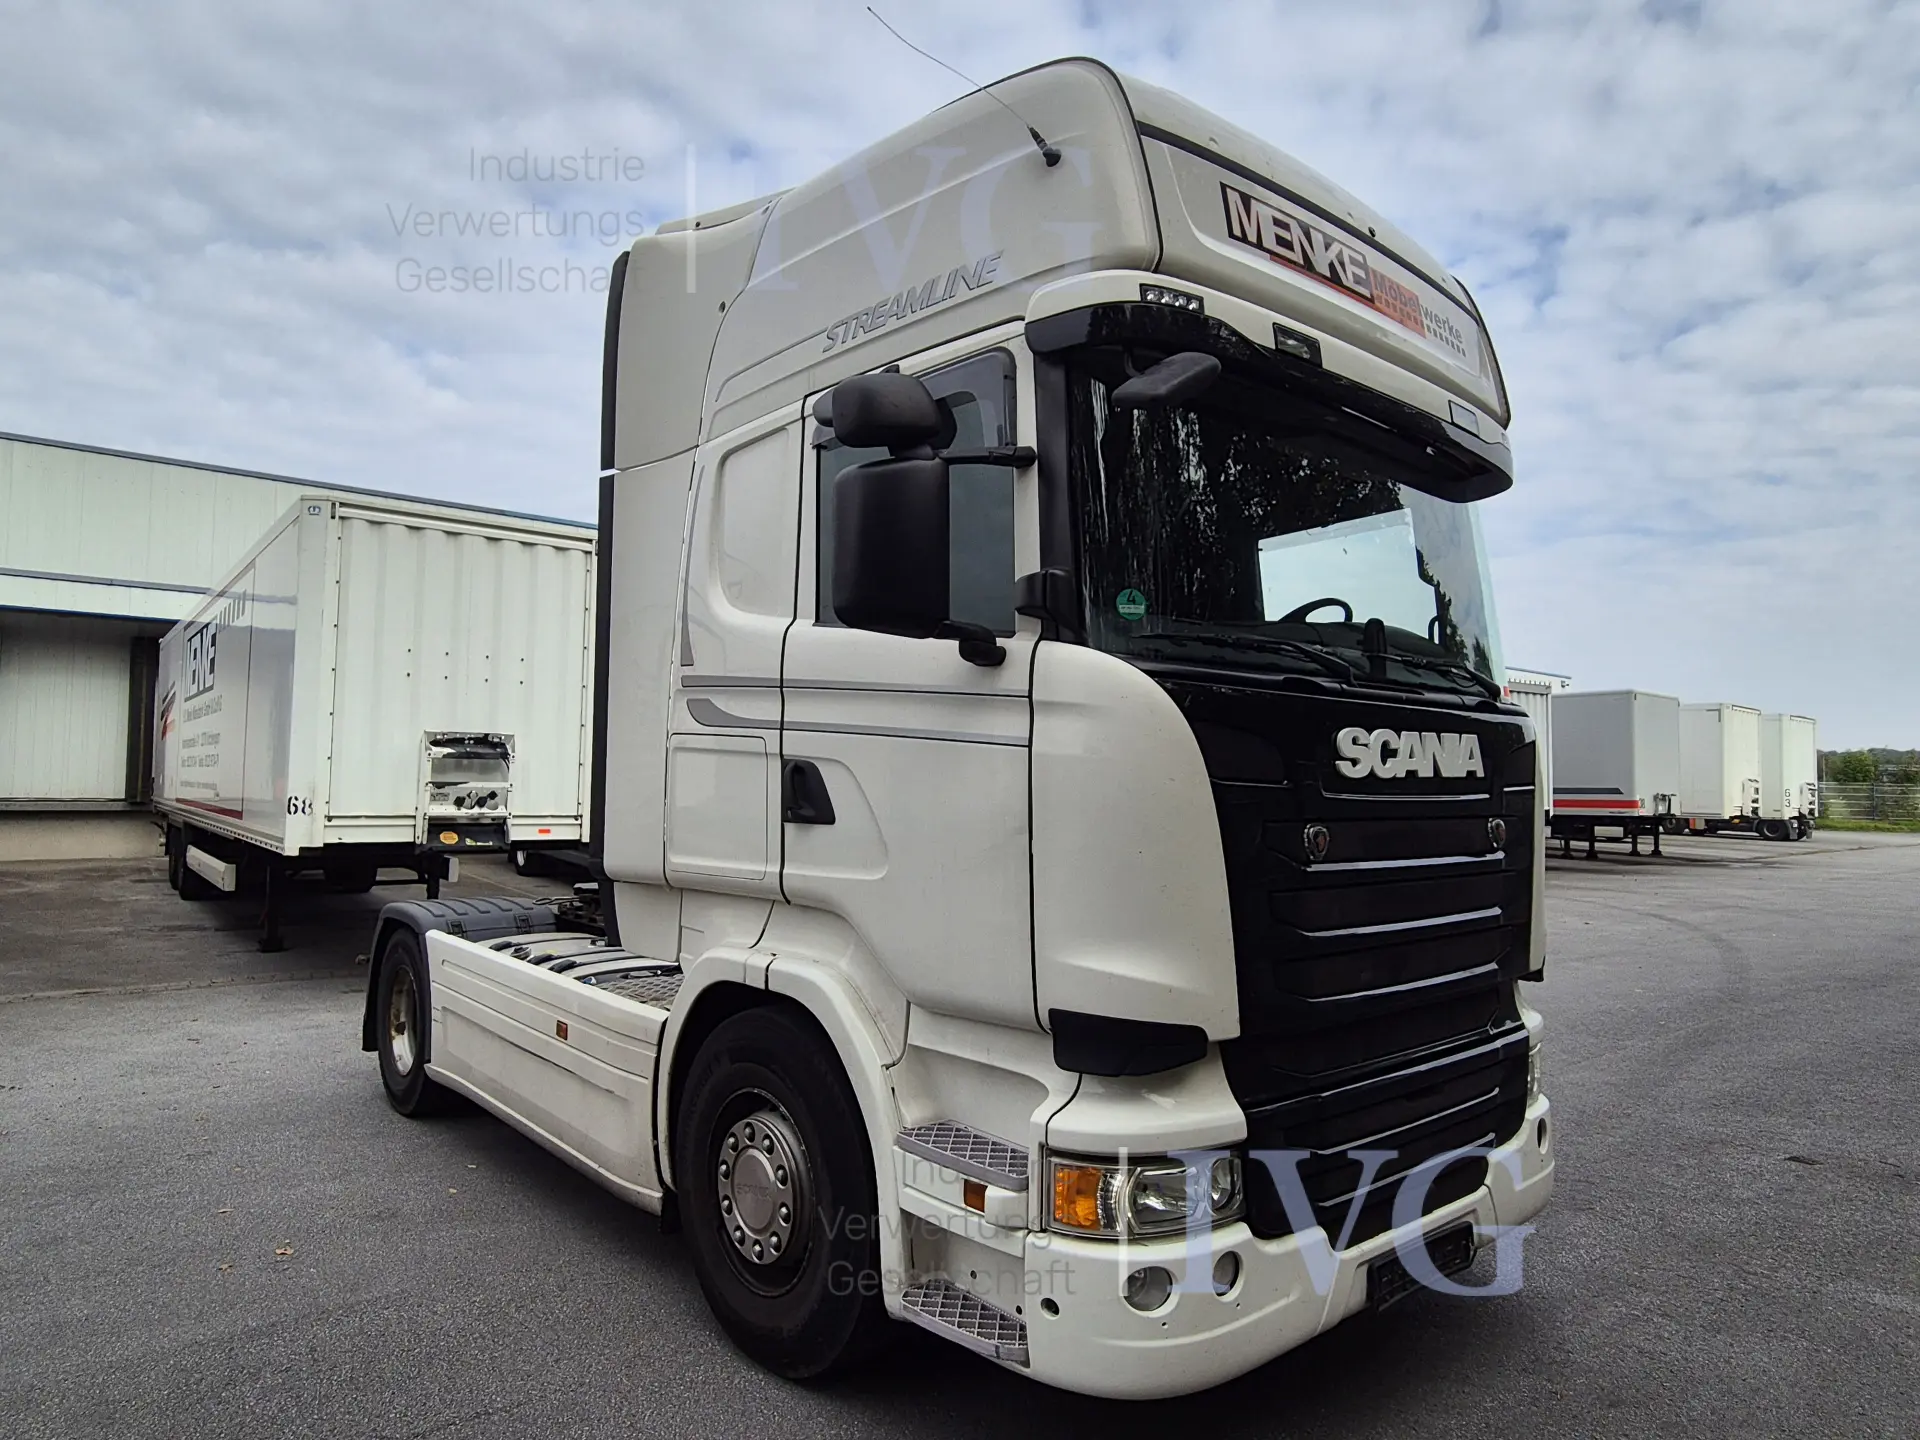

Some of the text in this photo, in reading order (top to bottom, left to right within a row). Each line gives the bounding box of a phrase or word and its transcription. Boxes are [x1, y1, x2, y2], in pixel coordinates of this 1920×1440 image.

[1225, 186, 1373, 300] MENKE
[822, 250, 1004, 353] STREAMLINE
[1127, 590, 1136, 605] 4
[1335, 727, 1485, 779] SCANIA
